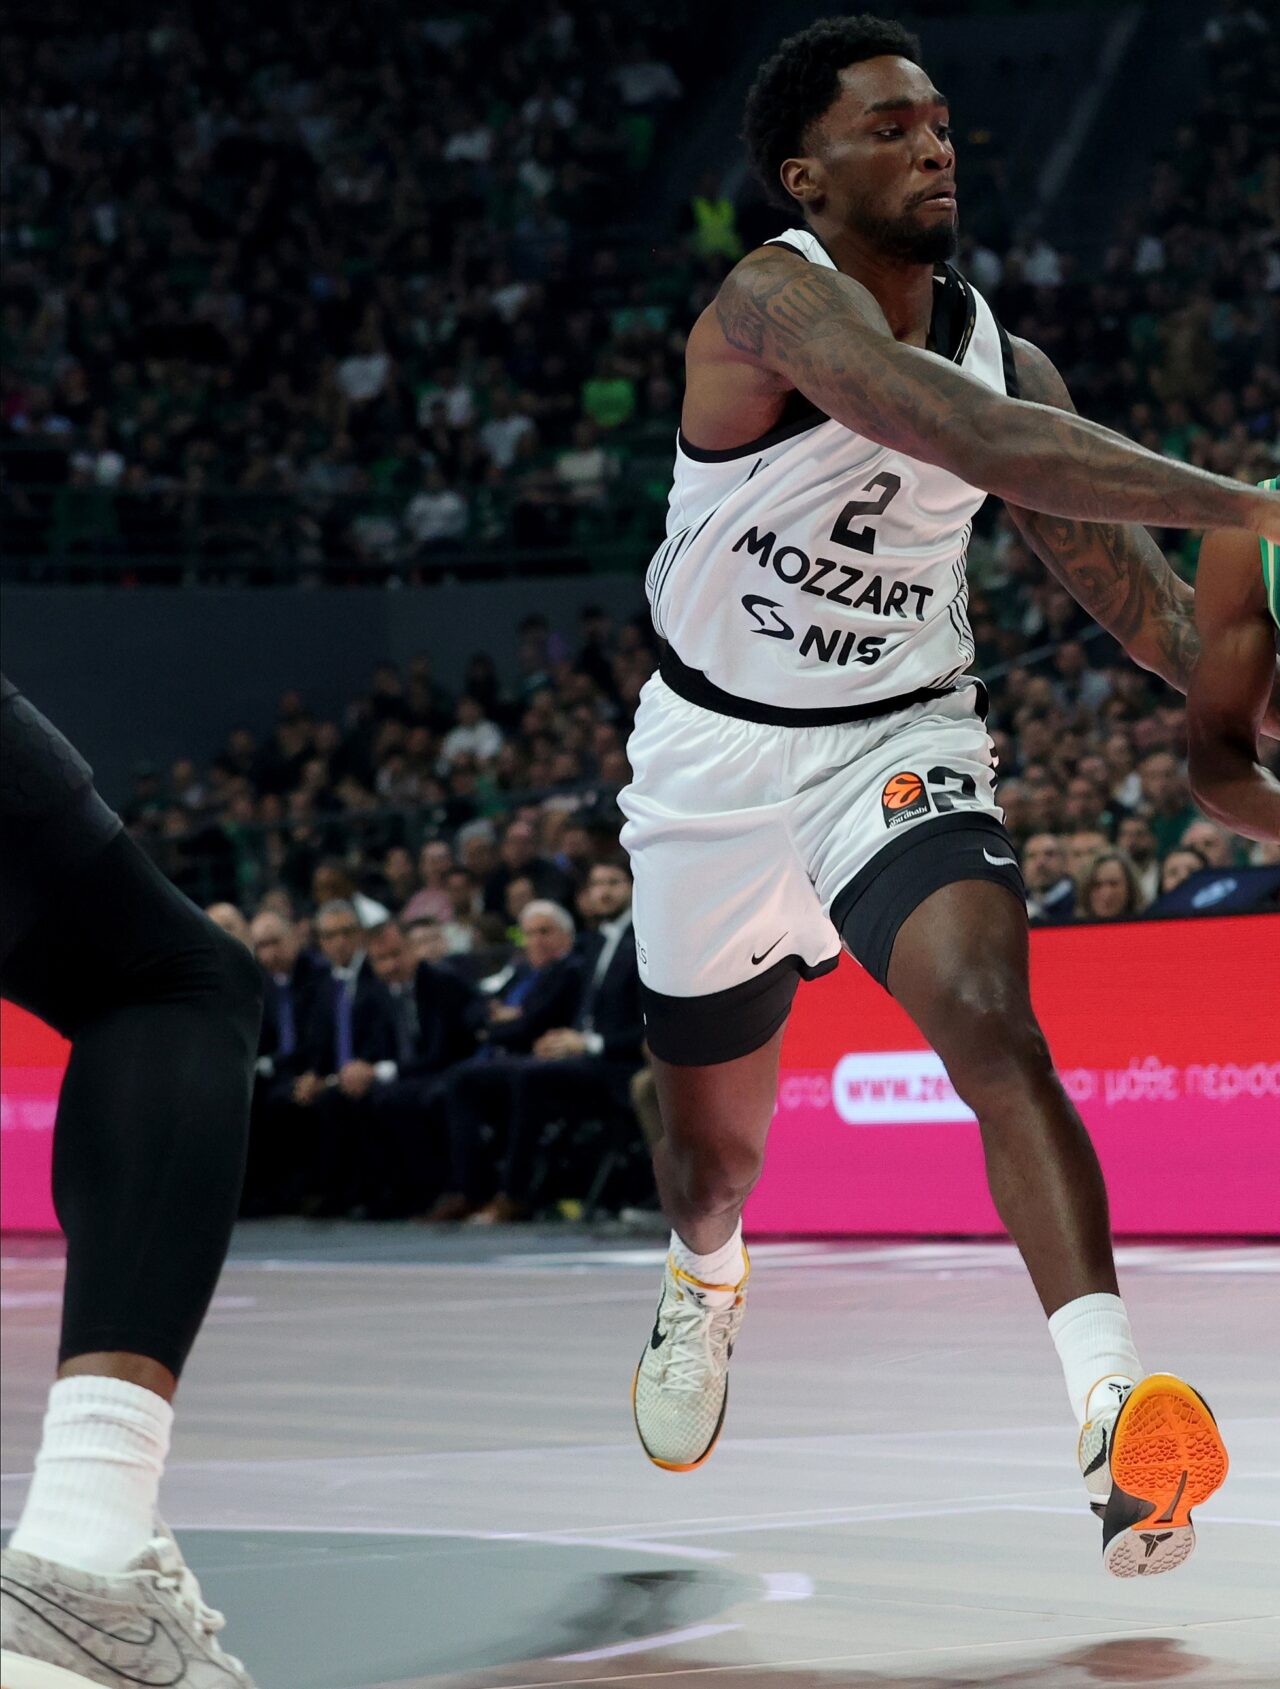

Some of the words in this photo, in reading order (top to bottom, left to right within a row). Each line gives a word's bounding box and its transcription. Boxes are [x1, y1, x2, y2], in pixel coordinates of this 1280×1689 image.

[829, 471, 901, 554] 2
[731, 526, 934, 621] MOZZART
[799, 624, 887, 666] NIS
